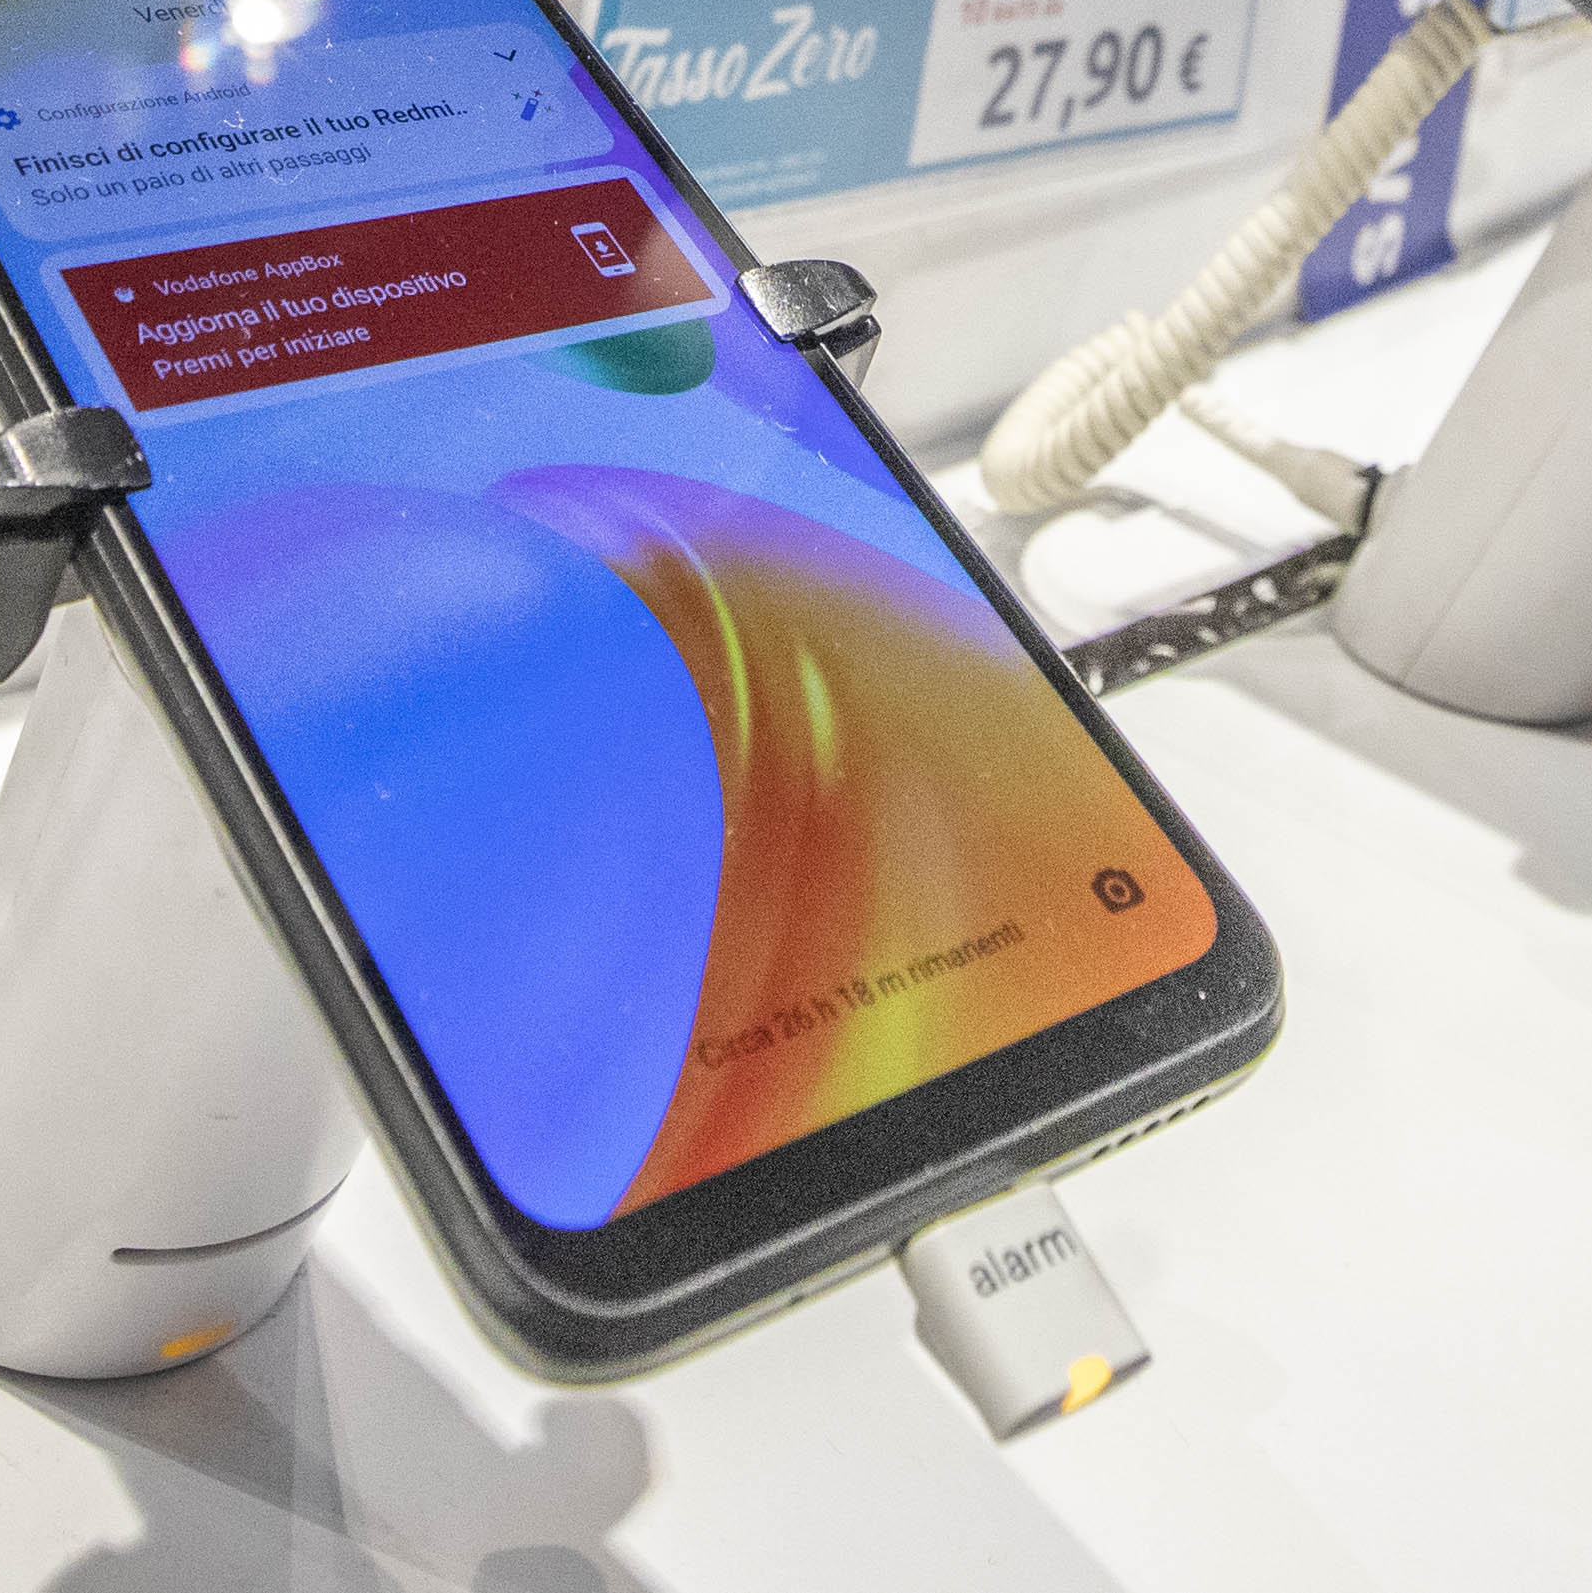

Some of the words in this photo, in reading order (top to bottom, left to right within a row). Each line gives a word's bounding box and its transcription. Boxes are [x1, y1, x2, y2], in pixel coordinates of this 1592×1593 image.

[602, 28, 748, 108] Tasso
[741, 4, 879, 101] Zero
[979, 22, 1164, 131] 27,90
[1177, 32, 1212, 94] €
[37, 90, 180, 125] Configurazione
[183, 82, 253, 107] Android
[13, 149, 111, 179] Finisci
[117, 141, 144, 163] di
[149, 120, 303, 161] configurare
[306, 116, 325, 136] il
[328, 111, 372, 134] tuo
[31, 185, 90, 209] Solo
[95, 179, 128, 199] un
[133, 169, 187, 198] paio
[190, 165, 215, 184] di
[220, 156, 267, 180] altri
[268, 141, 374, 178] passaggi
[137, 307, 261, 347] Aggiorna
[263, 298, 281, 322] il
[281, 293, 330, 319] tuo
[330, 269, 469, 309] dispositivo
[153, 268, 260, 297] Vodafone
[263, 252, 345, 281] AppBox
[151, 347, 234, 381] Premi
[236, 340, 280, 369] per
[282, 324, 373, 357] iniziare
[836, 975, 877, 1008] 18
[874, 968, 909, 997] m
[906, 919, 1027, 986] rimanenti
[968, 1222, 1078, 1298] alarm
